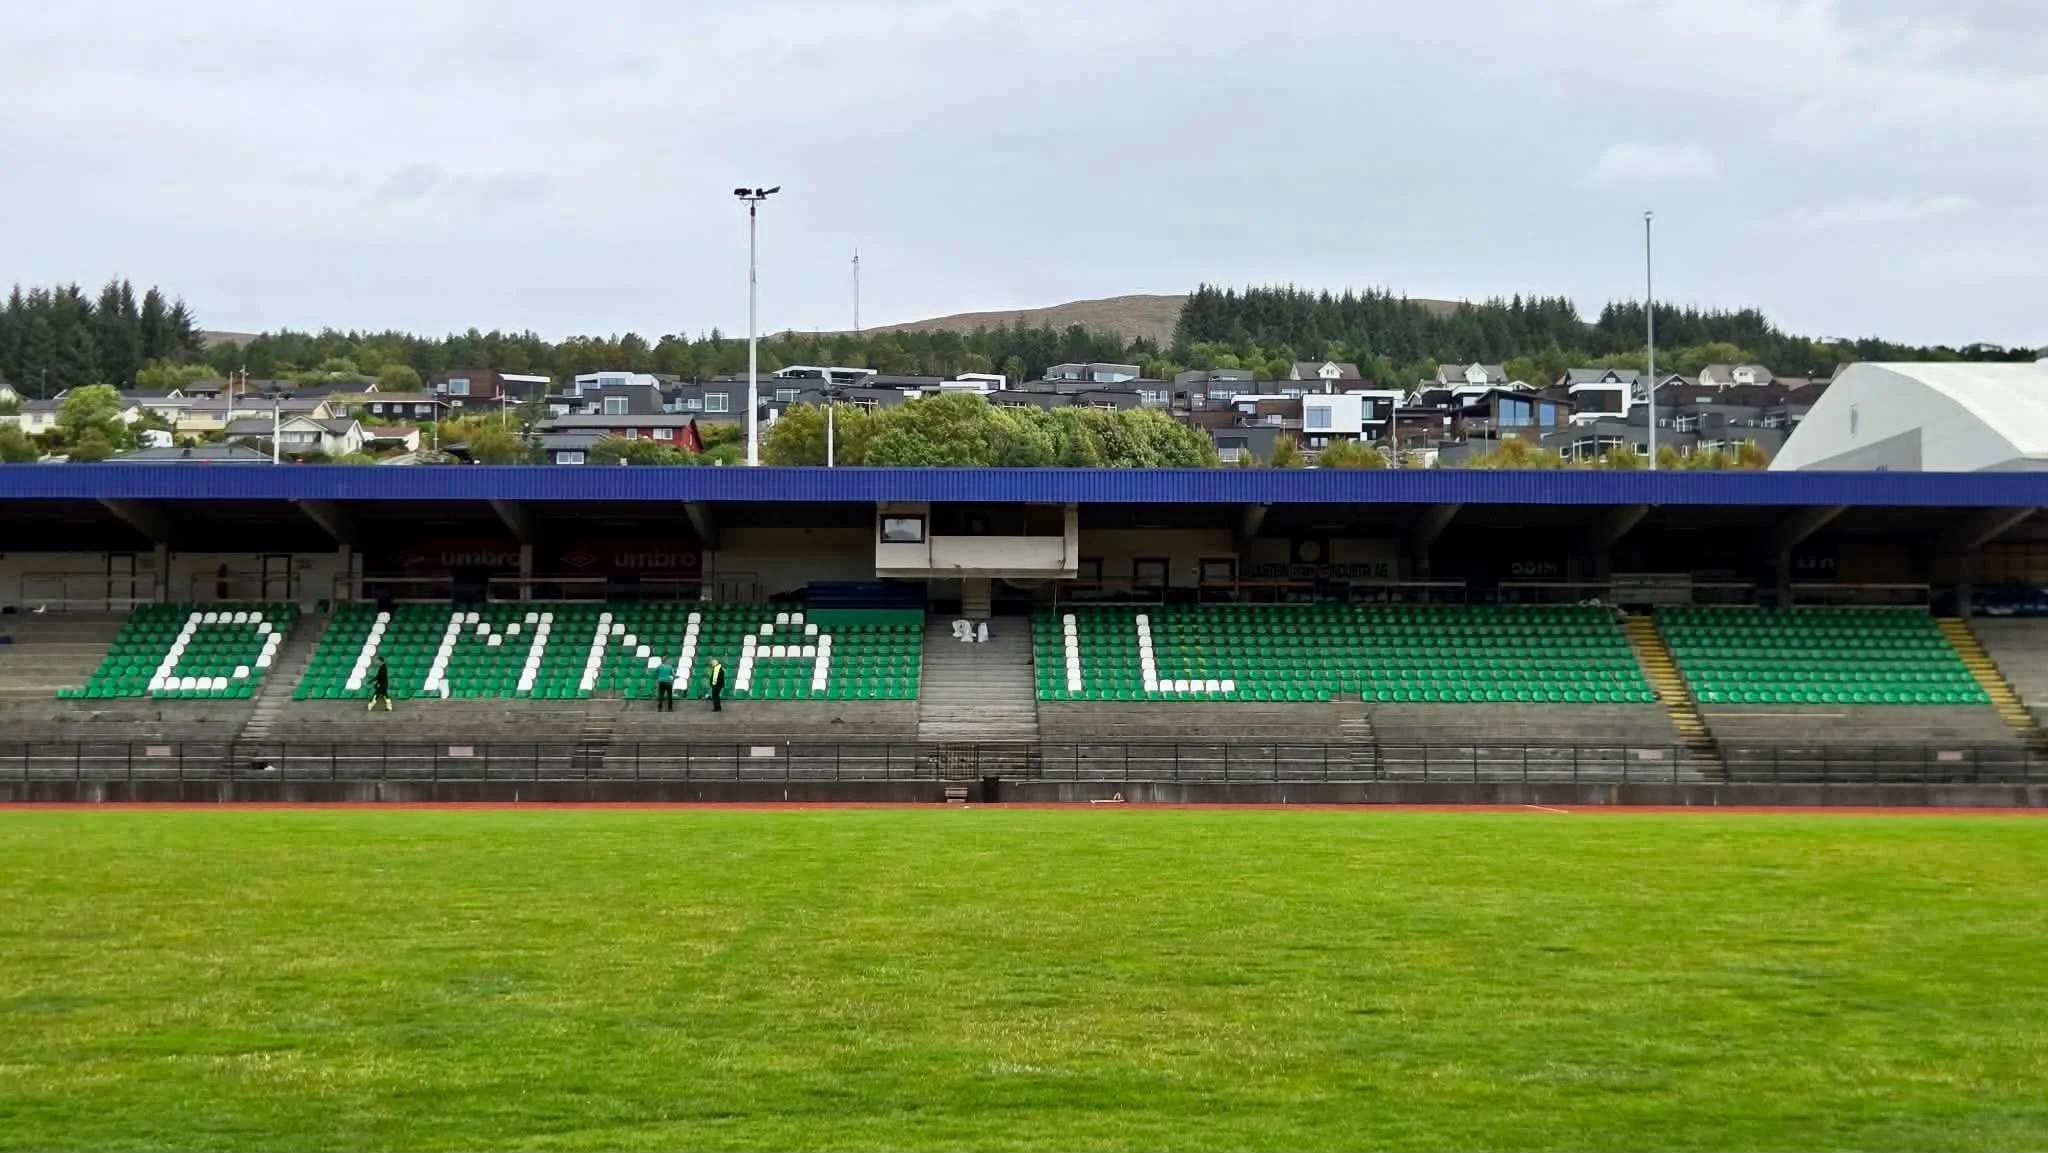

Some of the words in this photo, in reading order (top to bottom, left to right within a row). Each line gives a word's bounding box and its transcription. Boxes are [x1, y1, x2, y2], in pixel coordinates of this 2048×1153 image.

[441, 548, 521, 568] umbro
[613, 546, 695, 566] umbro
[147, 611, 833, 693] DIMNA
[1062, 613, 1236, 695] IL
